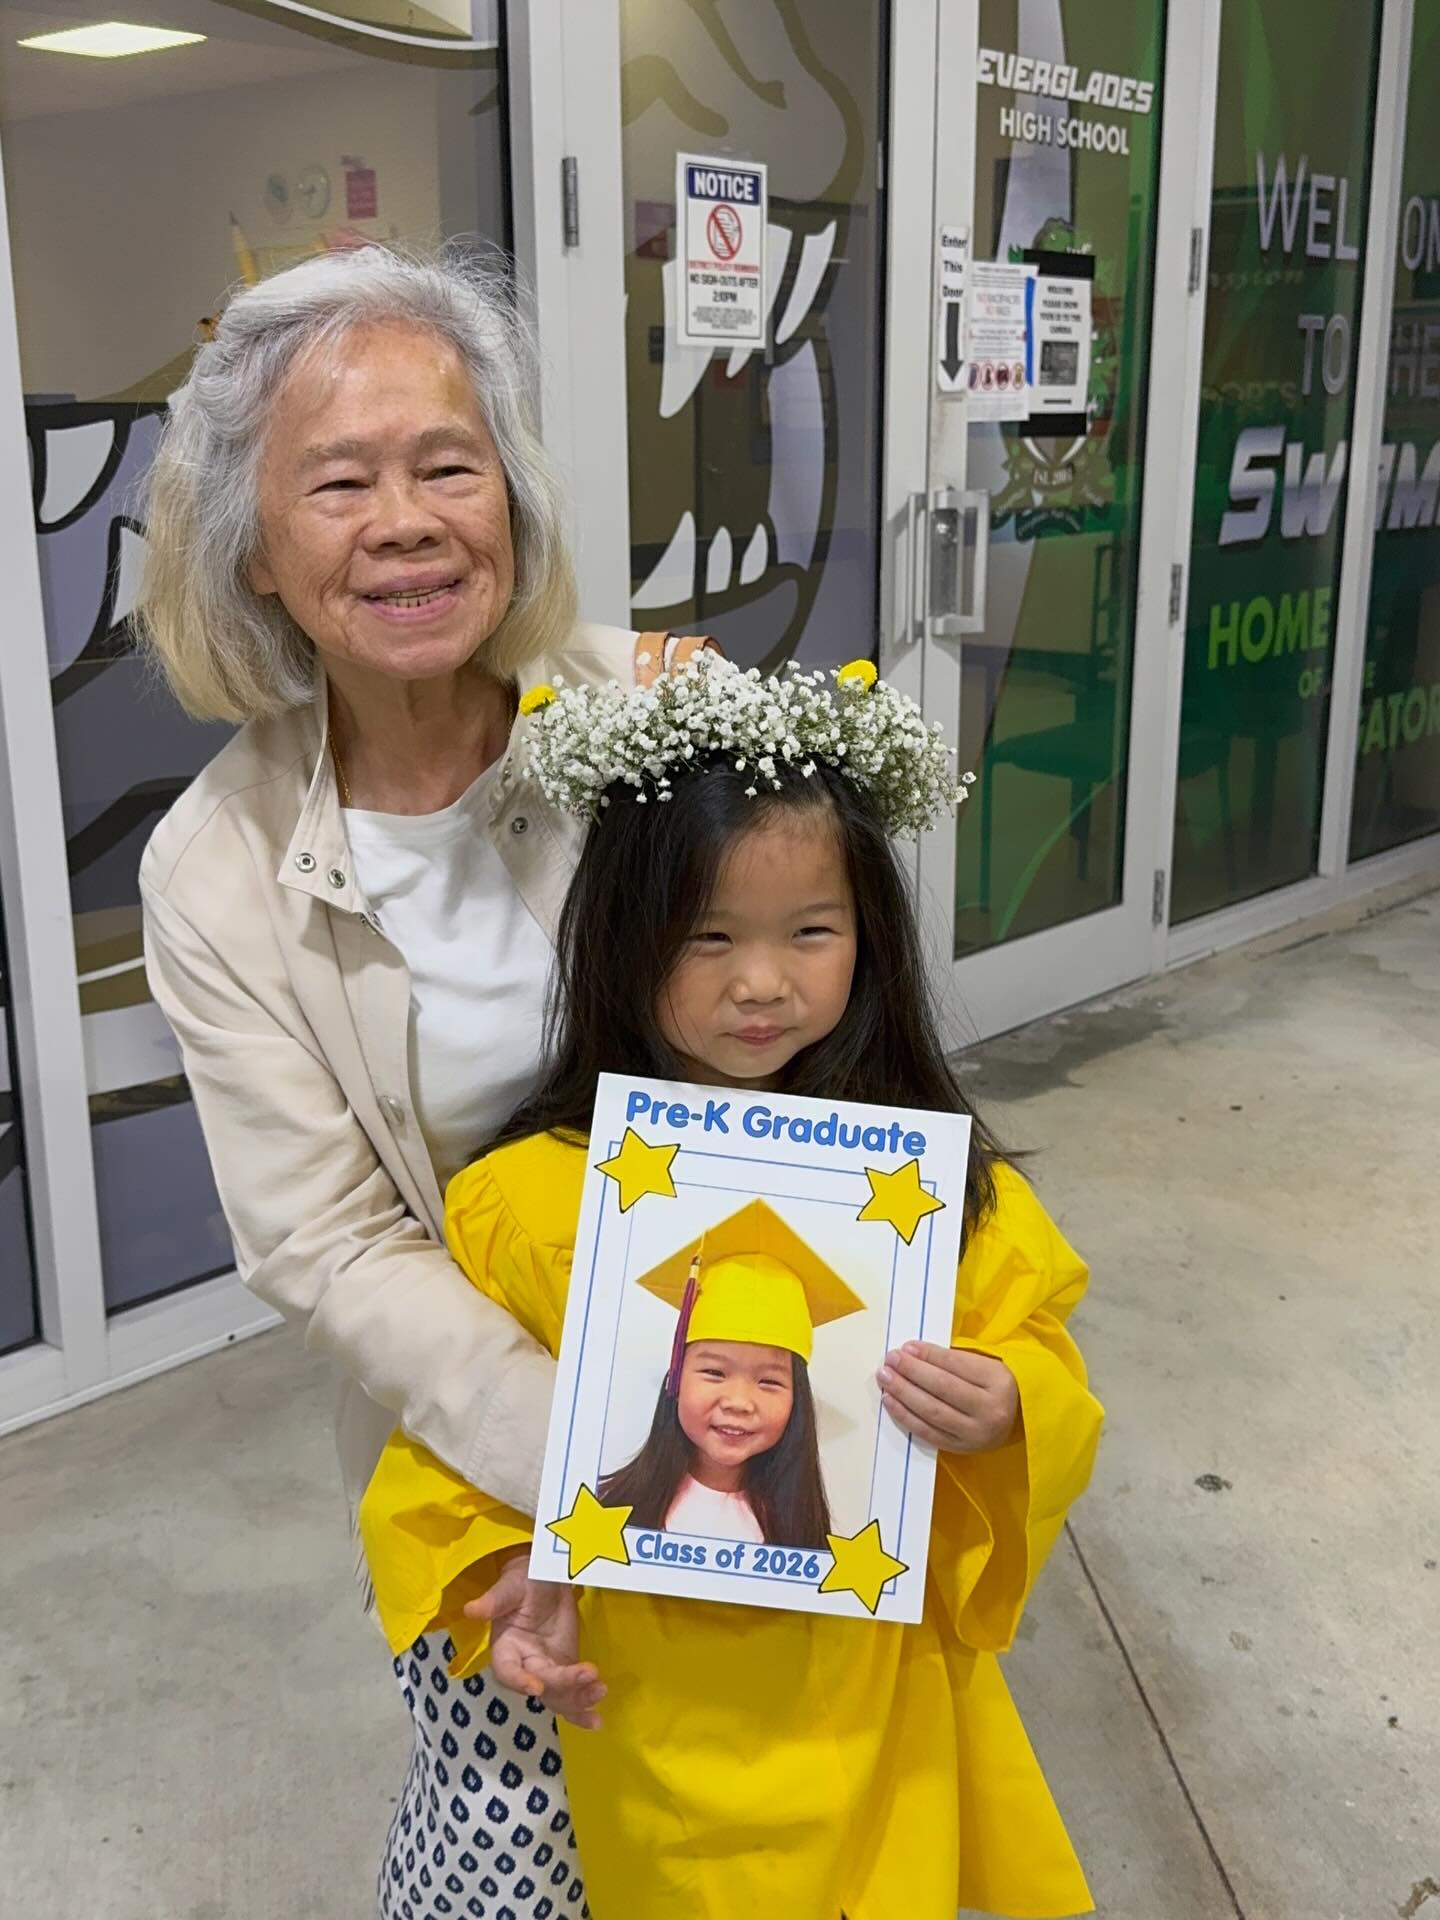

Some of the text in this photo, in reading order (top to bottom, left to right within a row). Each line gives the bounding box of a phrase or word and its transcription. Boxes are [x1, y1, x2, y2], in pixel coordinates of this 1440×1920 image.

[976, 48, 1154, 114] EVERGLADES
[1000, 106, 1130, 155] HIGH SCHOOL
[693, 169, 754, 201] NOTICE
[941, 235, 968, 248] Enter
[943, 260, 963, 273] This
[942, 285, 964, 298] Door
[1296, 313, 1351, 396] TO
[1207, 587, 1333, 670] HOME
[1357, 684, 1440, 754] ATOR
[626, 1091, 927, 1156] Pre-K Graduate
[636, 1533, 820, 1579] Class of 2026
